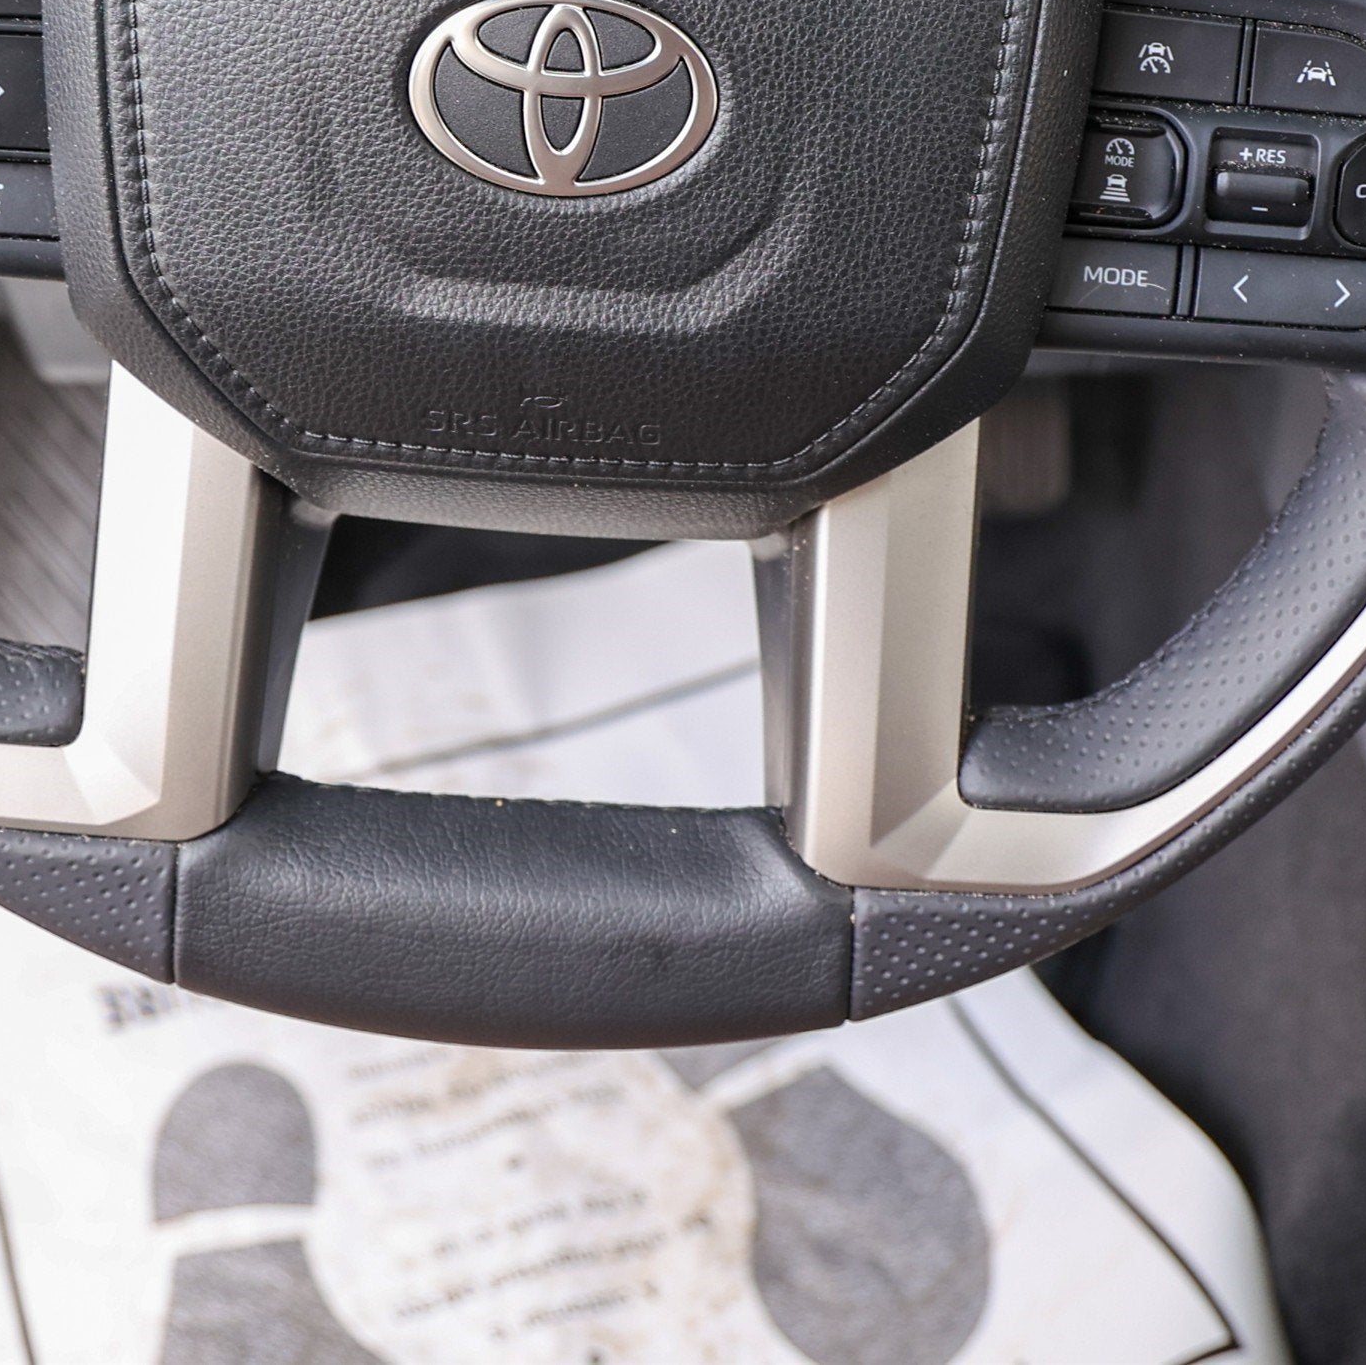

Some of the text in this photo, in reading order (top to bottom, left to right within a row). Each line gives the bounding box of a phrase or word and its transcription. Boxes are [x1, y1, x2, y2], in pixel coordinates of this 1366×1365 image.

[1104, 154, 1135, 169] MODE
[1082, 265, 1150, 288] MODE
[424, 409, 663, 447] SRS AIRBAG
